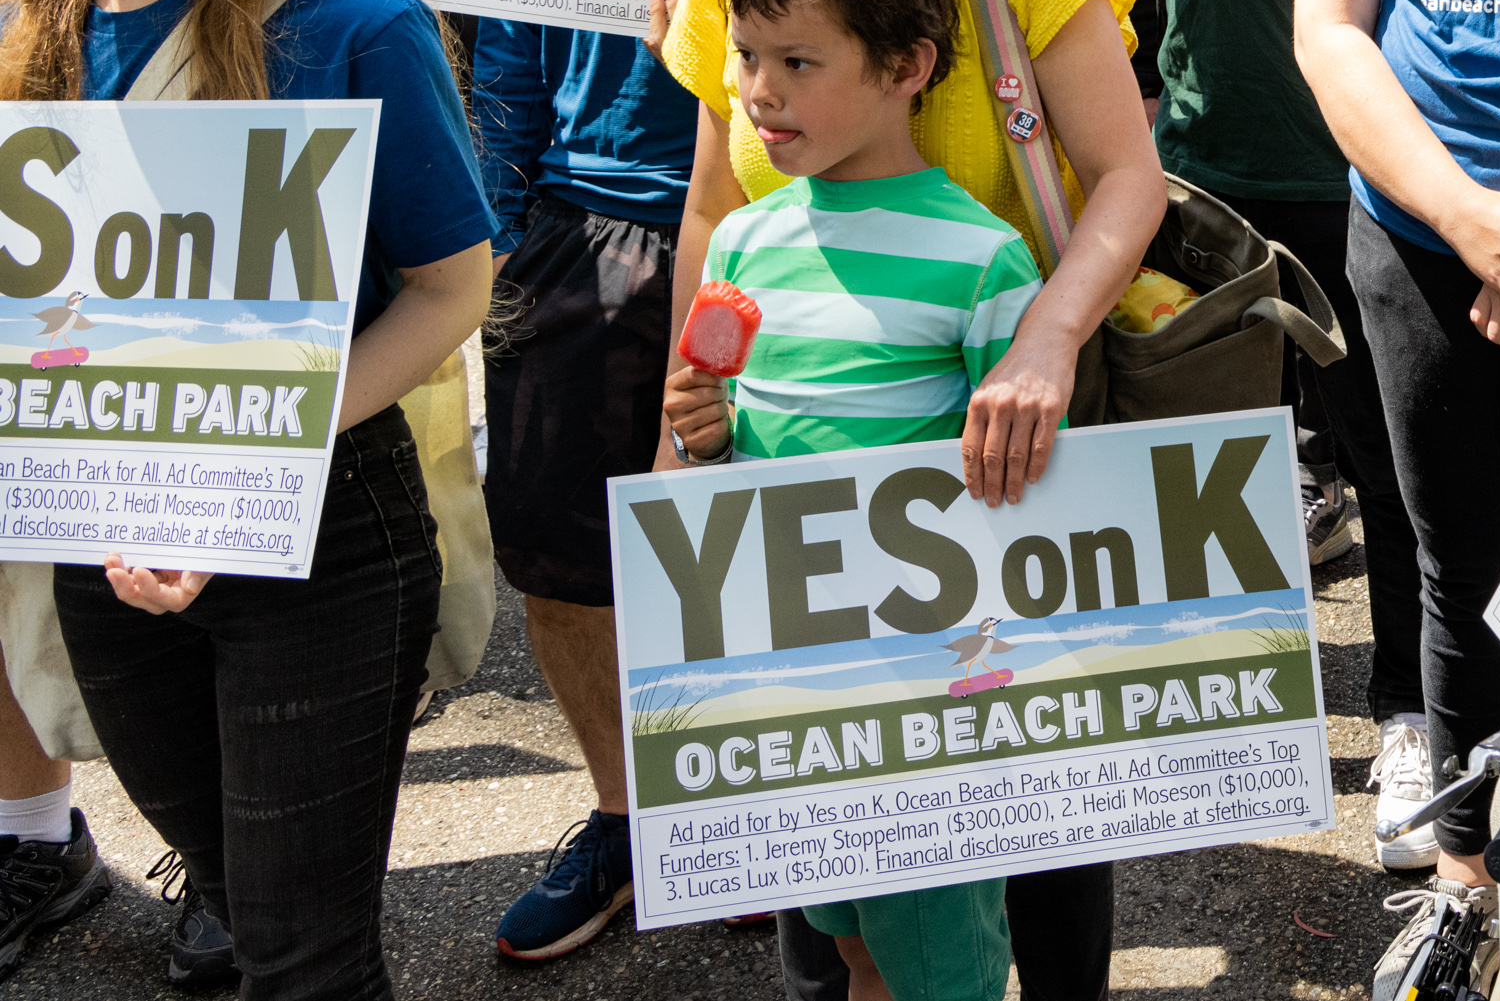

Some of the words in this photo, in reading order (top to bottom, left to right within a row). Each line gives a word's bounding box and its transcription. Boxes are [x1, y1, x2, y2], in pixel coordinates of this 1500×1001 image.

[1019, 114, 1033, 129] 38
[95, 210, 215, 300] on
[233, 127, 355, 302] K
[172, 383, 308, 437] PARK
[631, 467, 978, 662] YES
[1002, 527, 1139, 619] on
[1150, 435, 1289, 602] K
[675, 719, 883, 791] OCEAN
[901, 689, 1104, 761] BEACH
[1121, 668, 1284, 731] PARK
[660, 849, 739, 875] Funders:
[745, 843, 758, 862] 1.
[765, 838, 826, 864] Jeremy
[833, 821, 939, 852] Stoppelman
[947, 800, 1054, 836] ($300,000),
[1062, 797, 1077, 817] 2.
[1083, 789, 1126, 814] Heidi
[1133, 783, 1211, 806] Moseson
[1219, 766, 1308, 797] ($10,000),
[669, 821, 693, 844] Ad
[701, 814, 739, 845] paid
[746, 812, 771, 832] for
[779, 808, 801, 833] by
[806, 803, 837, 824] Yes
[843, 803, 866, 819] on
[872, 794, 890, 815] K,
[896, 791, 953, 811] Ocean
[959, 777, 1015, 803] Beach
[1021, 770, 1061, 794] Park
[1067, 767, 1091, 787] for
[1098, 761, 1122, 785] All.
[1128, 757, 1151, 781] Ad
[1157, 744, 1262, 778] Committee's
[1267, 740, 1300, 764] Top
[666, 881, 682, 901] 3.
[688, 876, 741, 897] Lucas
[747, 869, 779, 889] Lux
[786, 854, 868, 885] ($5,000).
[876, 840, 953, 870] Financial
[960, 830, 1059, 858] disclosures
[1066, 825, 1096, 845] are
[1101, 809, 1176, 837] available
[1184, 807, 1200, 828] at
[1206, 797, 1309, 823] sfethics.org.
